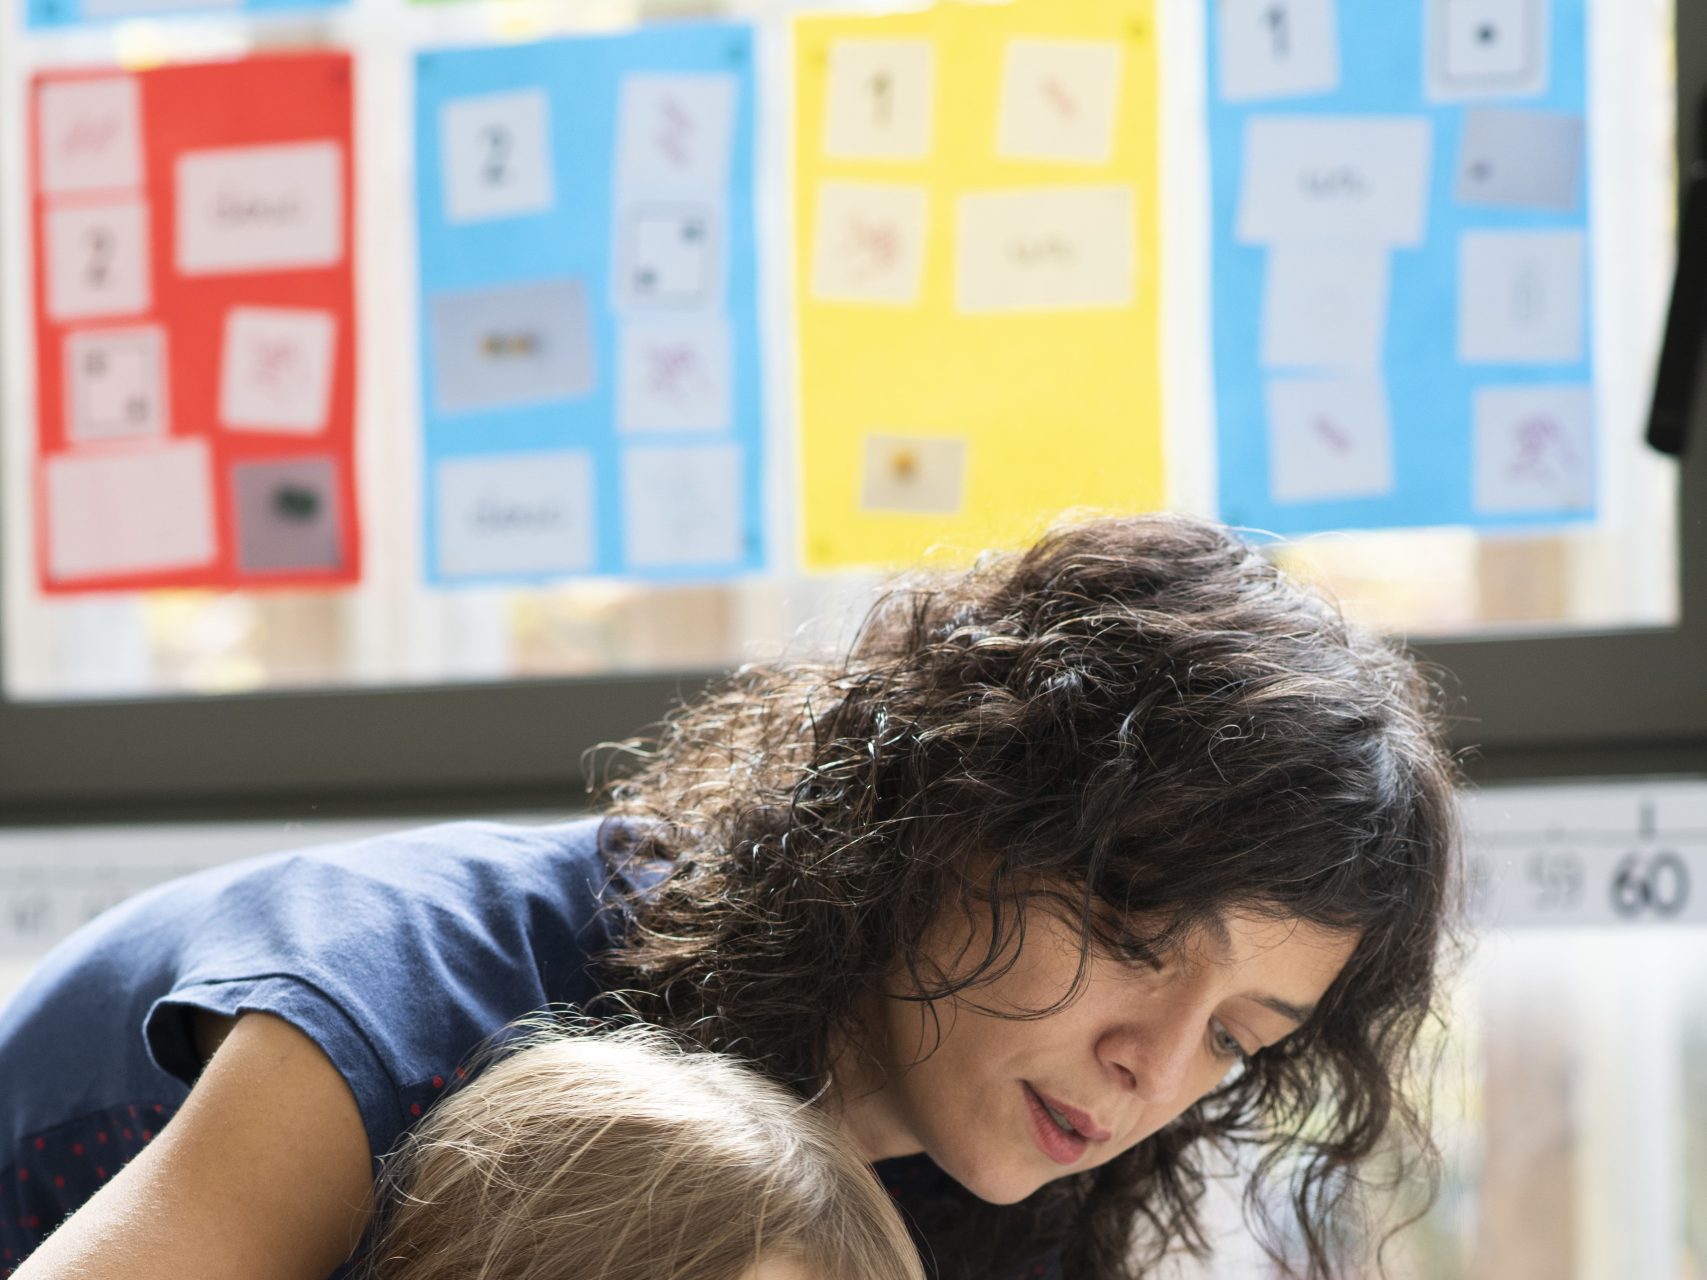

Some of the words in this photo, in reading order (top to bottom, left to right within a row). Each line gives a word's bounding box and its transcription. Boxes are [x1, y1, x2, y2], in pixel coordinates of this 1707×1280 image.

[481, 122, 513, 188] 2
[83, 228, 117, 292] 2
[1610, 850, 1690, 918] 60
